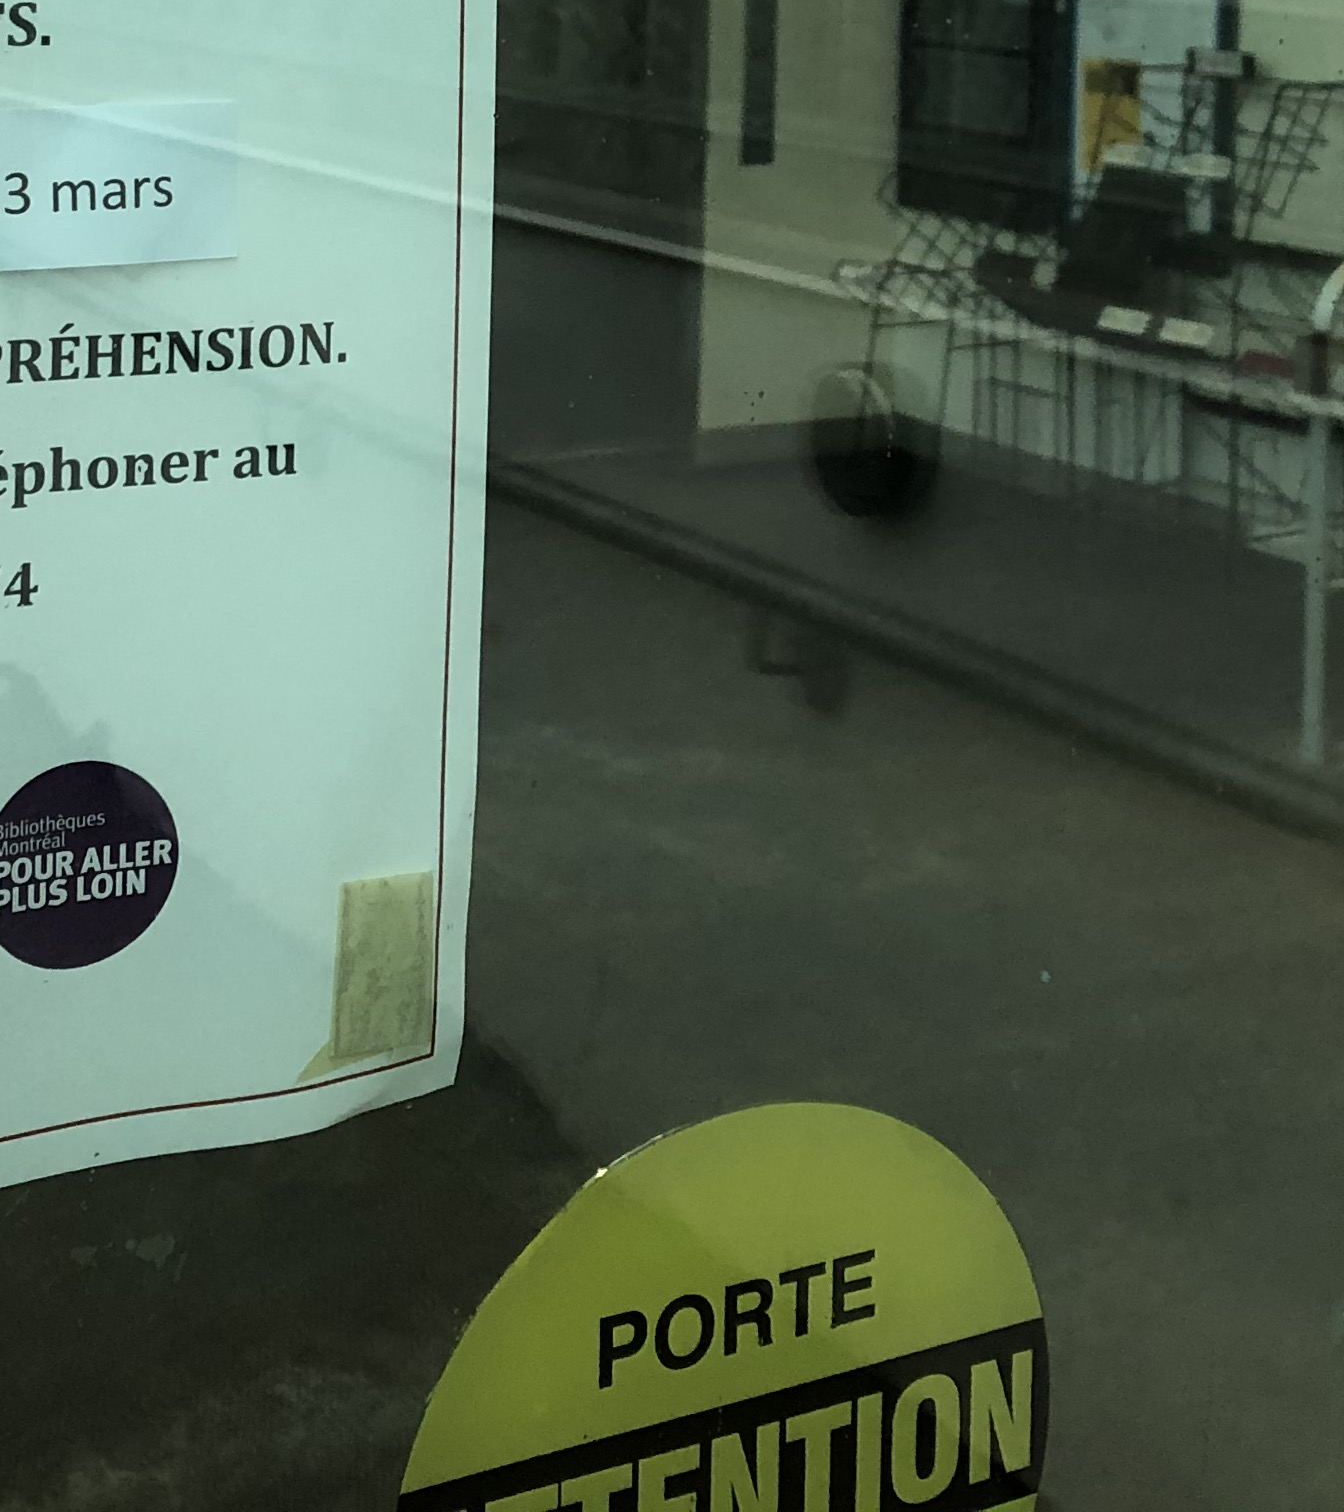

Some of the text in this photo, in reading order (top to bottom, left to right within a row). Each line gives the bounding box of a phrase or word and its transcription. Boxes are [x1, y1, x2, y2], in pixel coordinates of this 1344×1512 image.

[52, 175, 174, 212] mars
[233, 443, 297, 479] au
[80, 839, 172, 874] ALLER
[76, 868, 146, 902] LOIN
[597, 1248, 876, 1390] PORTE
